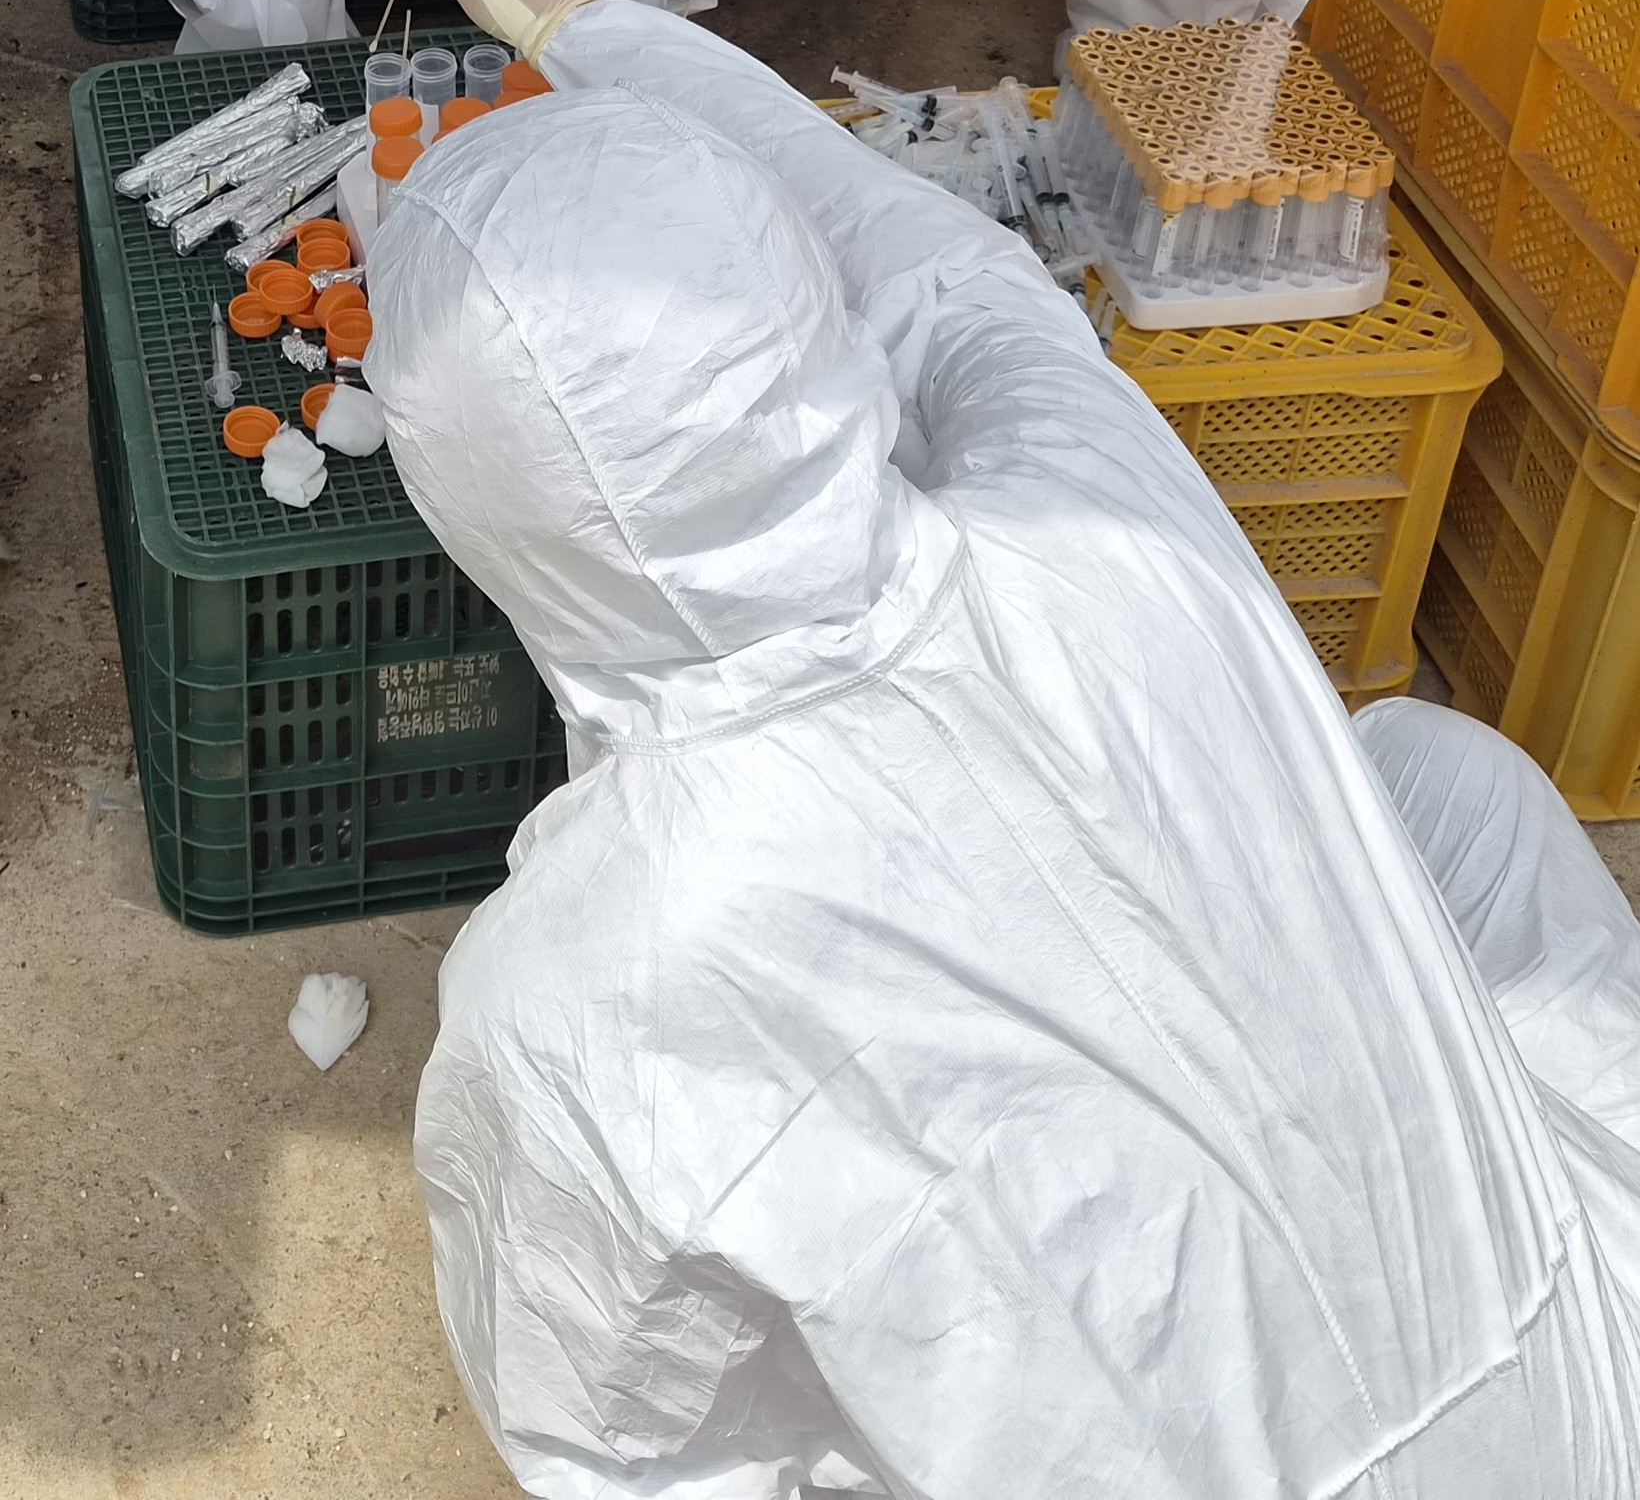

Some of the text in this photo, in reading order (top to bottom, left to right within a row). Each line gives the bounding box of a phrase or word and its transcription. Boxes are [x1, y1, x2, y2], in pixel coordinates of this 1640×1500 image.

[377, 665, 400, 689] 없음
[402, 663, 415, 685] 수
[452, 655, 476, 678] 또는
[385, 684, 430, 715] 타인에게
[448, 704, 482, 731] 상자는
[486, 706, 498, 727] 이
